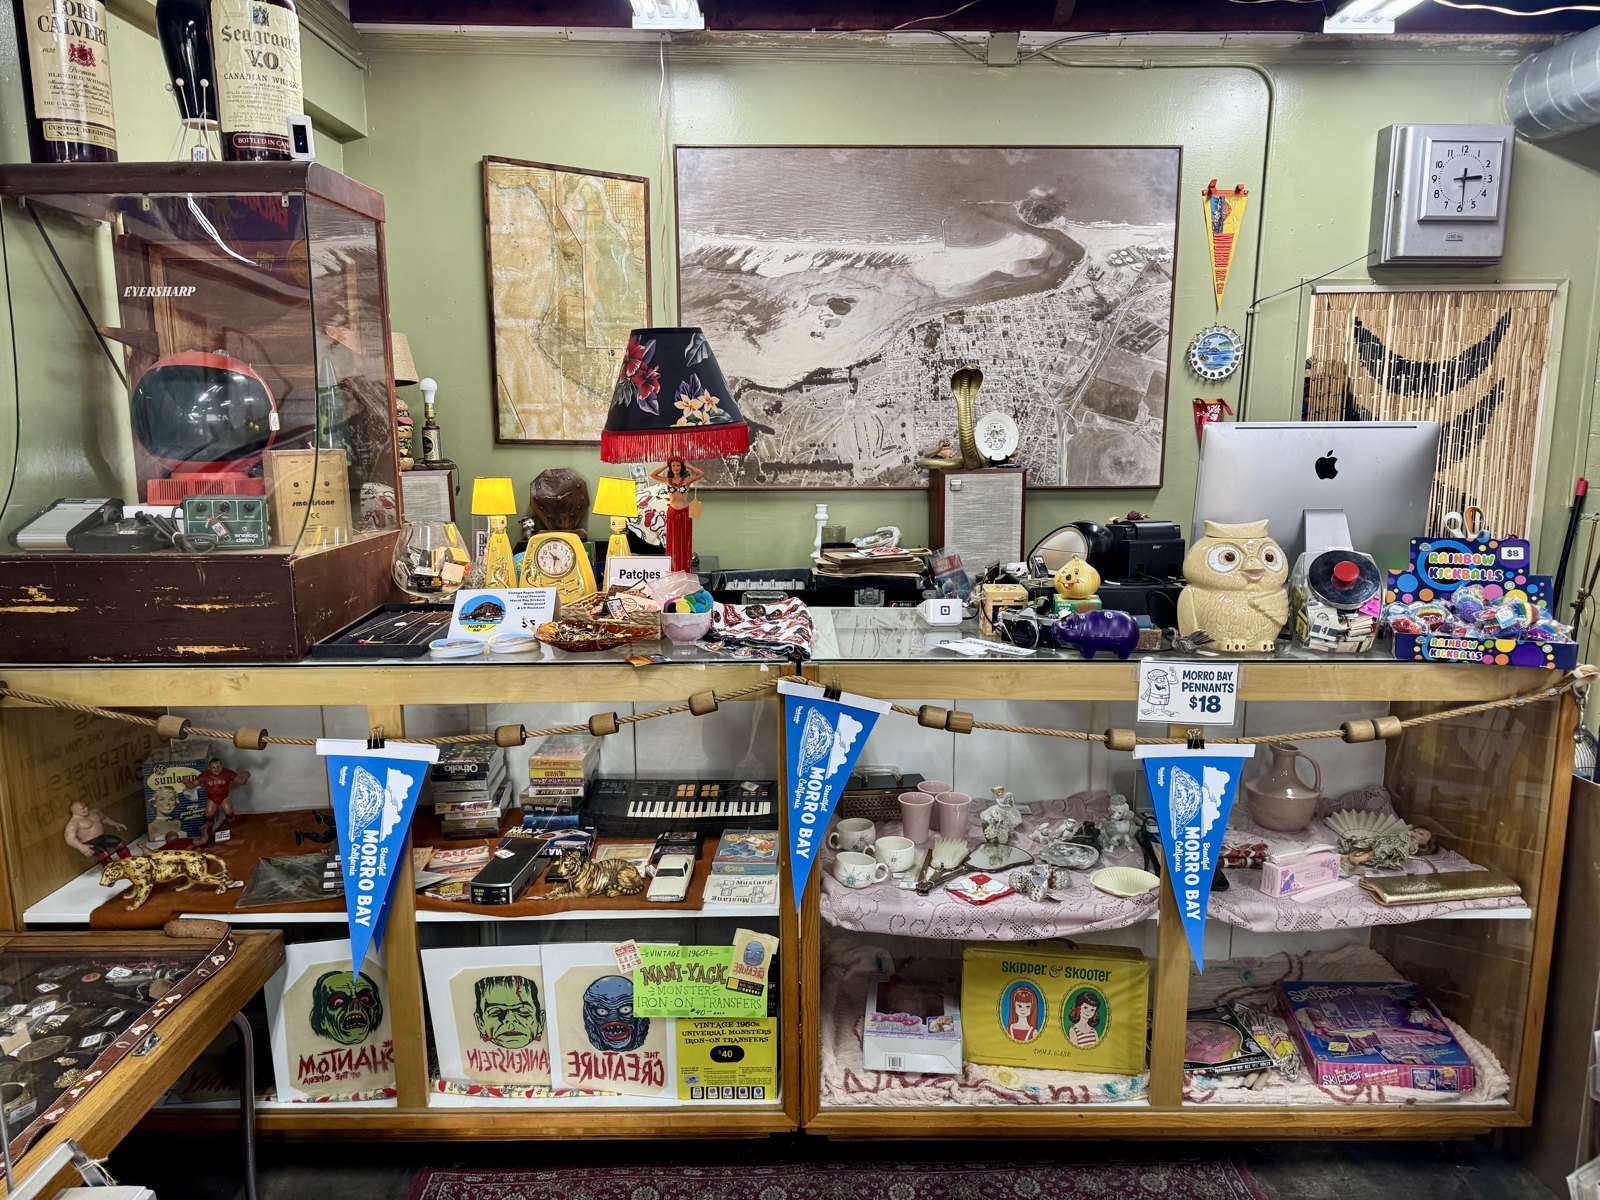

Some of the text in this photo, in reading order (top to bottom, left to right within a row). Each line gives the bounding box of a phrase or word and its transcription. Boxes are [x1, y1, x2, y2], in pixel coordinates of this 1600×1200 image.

[37, 15, 107, 46] CALVERT
[245, 49, 284, 72] V.O.
[224, 72, 268, 83] CANADIAN
[238, 137, 267, 145] BOTTLED
[1447, 150, 1454, 158] 11
[1461, 145, 1469, 154] 12
[1435, 160, 1443, 169] 10
[1486, 160, 1491, 168] 2
[1431, 175, 1438, 183] 9
[1487, 174, 1493, 183] 3
[1433, 189, 1440, 199] 8
[1481, 189, 1487, 198] 4
[1444, 201, 1449, 210] 7
[1470, 201, 1476, 209] 5
[123, 286, 196, 297] EVERSHARP
[1506, 549, 1519, 558] $8
[1428, 552, 1496, 567] RAINBOW
[619, 569, 661, 579] Patches
[1428, 567, 1504, 581] KICKBALLS
[1430, 638, 1478, 650] RAINBOW
[1429, 649, 1483, 661] KICKBALLS
[1182, 670, 1234, 681] MORRO BAY
[1181, 682, 1234, 693] PENNANTS
[1189, 695, 1222, 713] $18
[444, 764, 479, 773] Othello
[794, 778, 807, 809] California
[820, 784, 833, 812] Beautiful
[796, 766, 826, 860] MORRO BAY
[348, 843, 360, 876] California
[378, 846, 389, 877] Beautiful
[1174, 840, 1184, 873] California
[1202, 841, 1211, 871] Beautiful
[355, 829, 380, 928] MORRO BAY
[1184, 826, 1201, 921] MORRO BAY
[650, 950, 681, 958] VINTAGE
[640, 961, 729, 986] MANI-YACK
[1048, 964, 1063, 979] &
[657, 986, 710, 996] MONSTER
[1286, 987, 1356, 1003] Skipper
[637, 997, 762, 1010] IRON-ON TRANSFERS
[693, 1021, 735, 1029] VINTAGE
[684, 1036, 769, 1045] IRON-ON TRANSFERS
[718, 1049, 733, 1058] $40
[1033, 1048, 1072, 1057] DOLL CASE
[1321, 1070, 1363, 1086] Skipper
